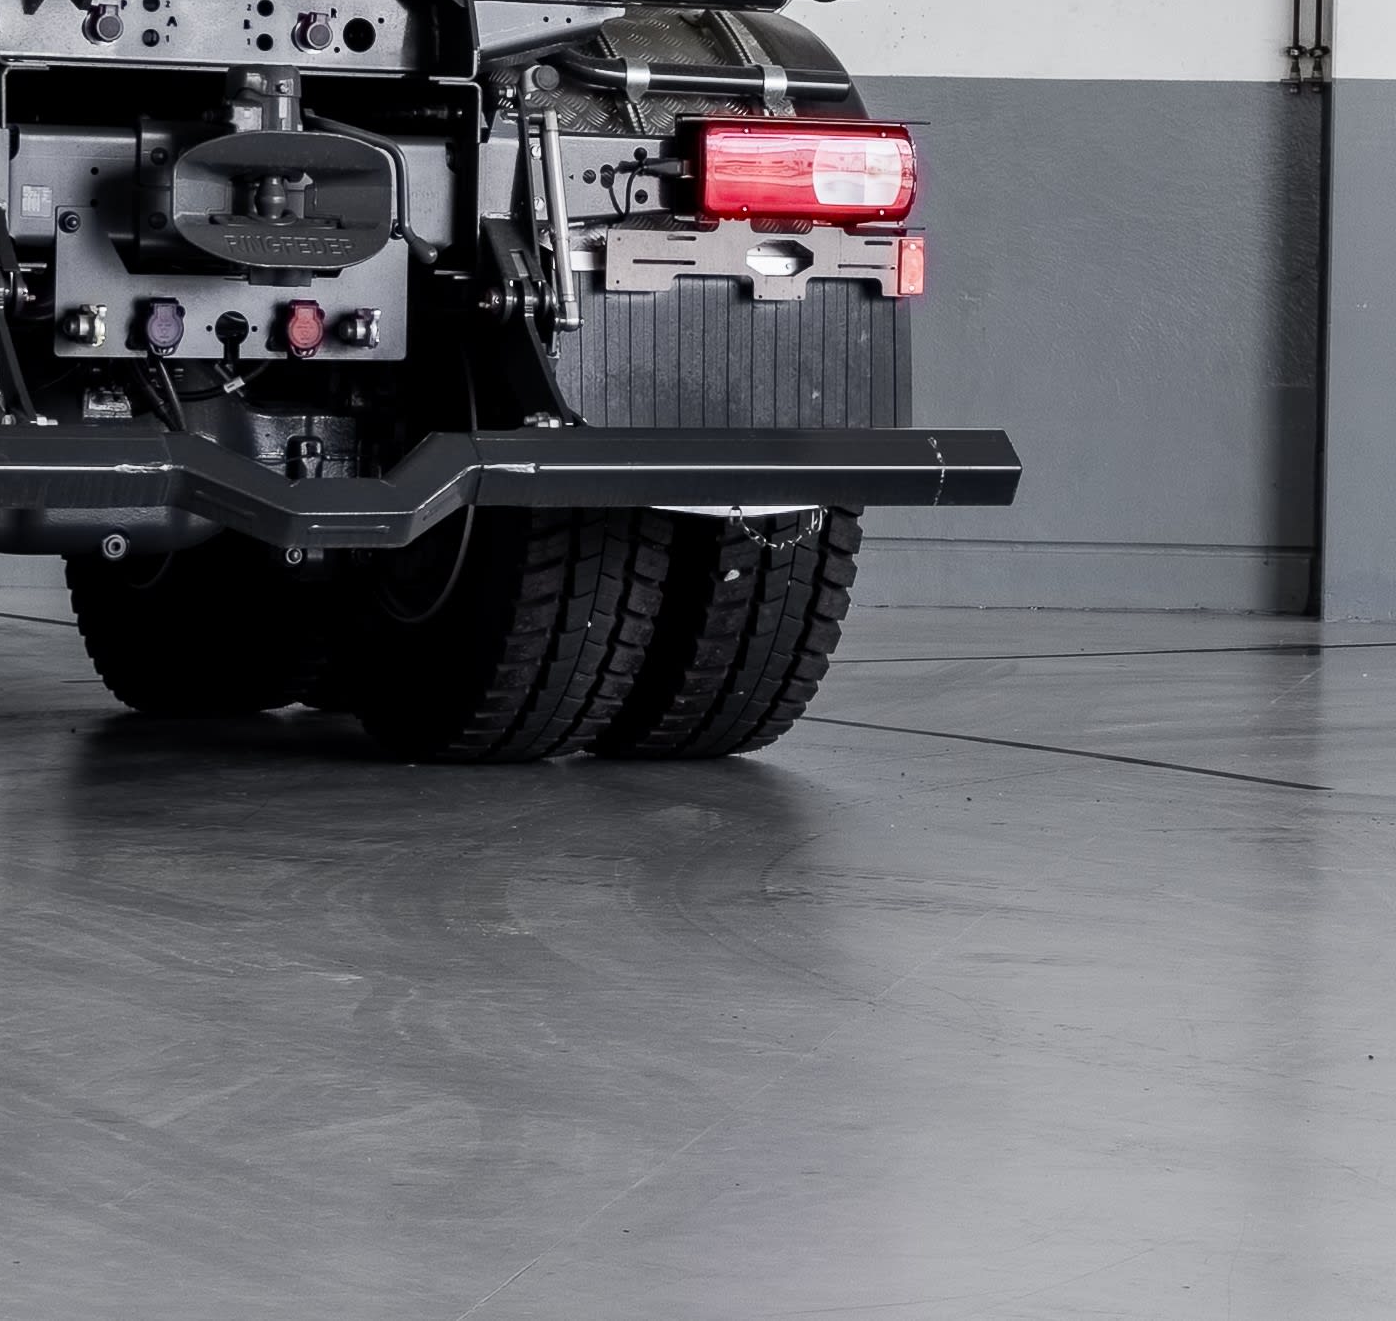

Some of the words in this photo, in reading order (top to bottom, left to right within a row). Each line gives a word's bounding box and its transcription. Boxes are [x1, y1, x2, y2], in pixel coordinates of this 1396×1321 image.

[120, 0, 128, 11] P
[330, 7, 338, 19] R
[166, 15, 178, 28] A
[222, 234, 354, 258] RINGFEDER
